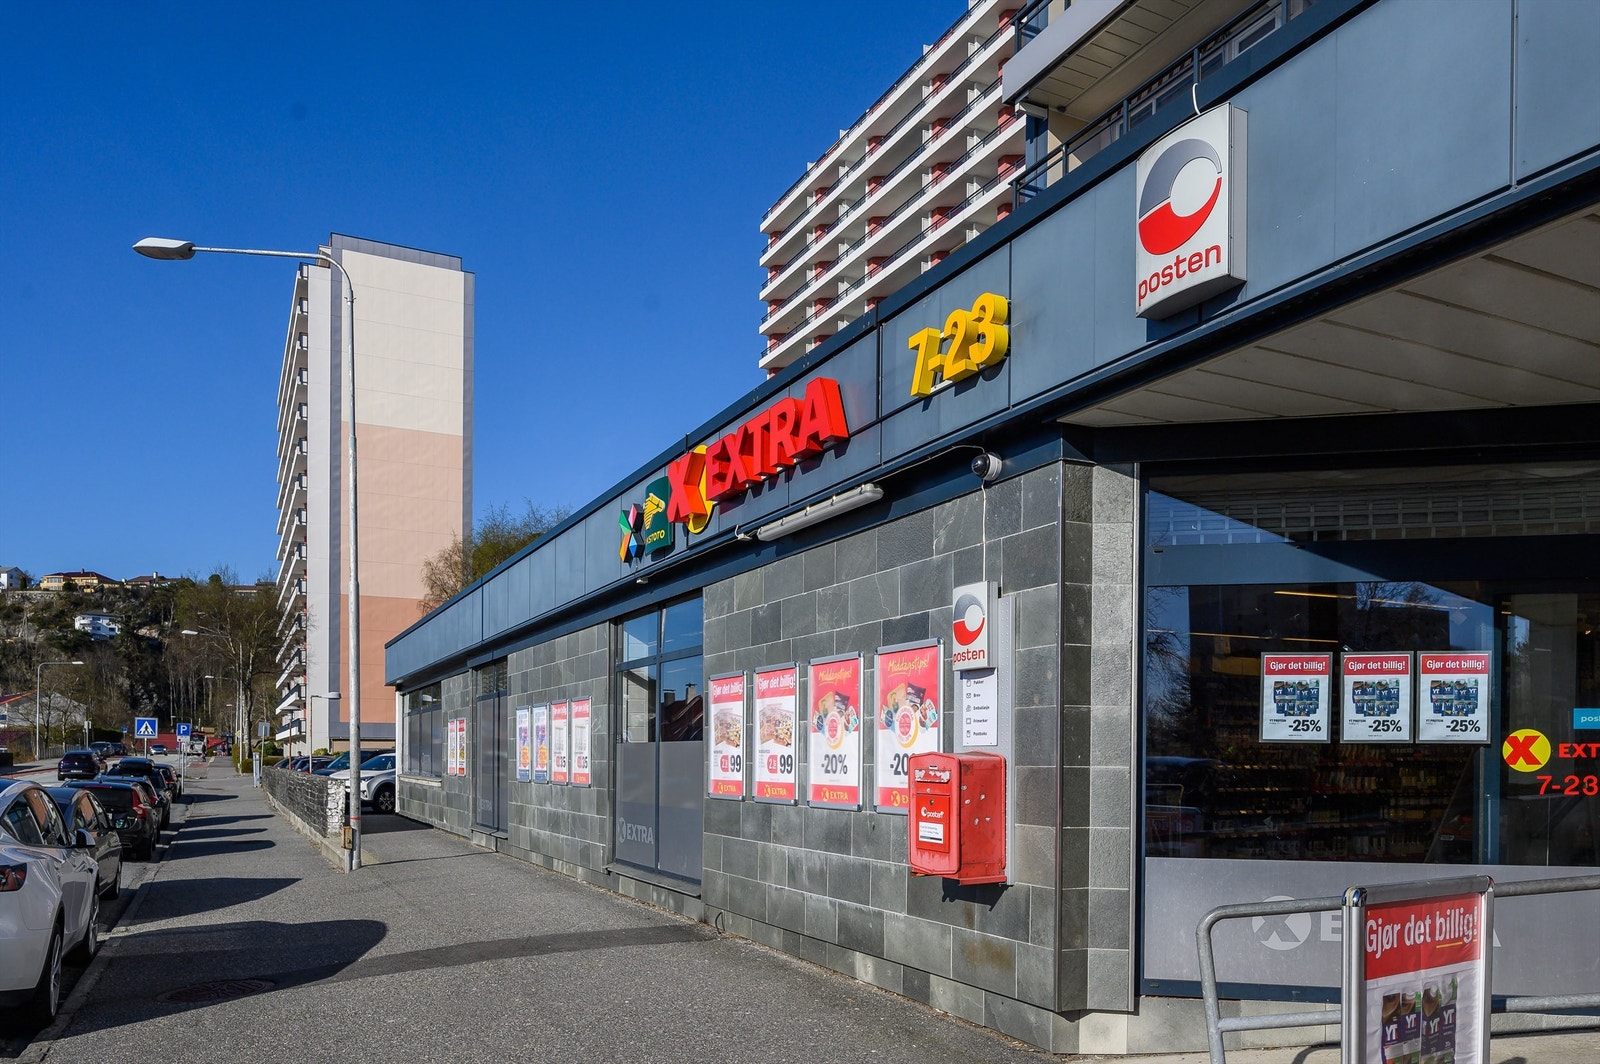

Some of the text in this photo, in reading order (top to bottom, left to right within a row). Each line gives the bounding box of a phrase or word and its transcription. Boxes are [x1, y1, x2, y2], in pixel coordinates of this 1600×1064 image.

[1138, 244, 1222, 306] posten
[908, 292, 1009, 398] 7-23
[706, 377, 848, 500] EXTRA
[953, 648, 986, 665] posten
[888, 654, 930, 676] Middagstips!
[1270, 662, 1288, 671] Gjør
[1304, 661, 1326, 671] billig!
[1348, 661, 1405, 671] Gjør det billig!
[1426, 660, 1444, 670] Gjør
[1462, 660, 1484, 670] billig!
[770, 676, 779, 689] det
[780, 673, 796, 689] billig!
[180, 724, 188, 734] P
[1289, 720, 1321, 732] -25%
[1368, 720, 1402, 732] -25%
[1446, 720, 1480, 732] -25%
[730, 754, 742, 773] 99
[780, 754, 793, 774] 99
[821, 754, 848, 775] -20%
[1536, 775, 1598, 796] 7-23
[830, 792, 849, 800] EXTRA
[627, 823, 654, 844] EXTRA
[1366, 918, 1400, 958] Gjør
[1404, 914, 1432, 947] det
[1436, 905, 1478, 944] billig!
[1406, 1014, 1416, 1029] YT
[1443, 1008, 1455, 1024] YT
[1385, 1024, 1398, 1041] YT
[1430, 1018, 1440, 1034] YT
